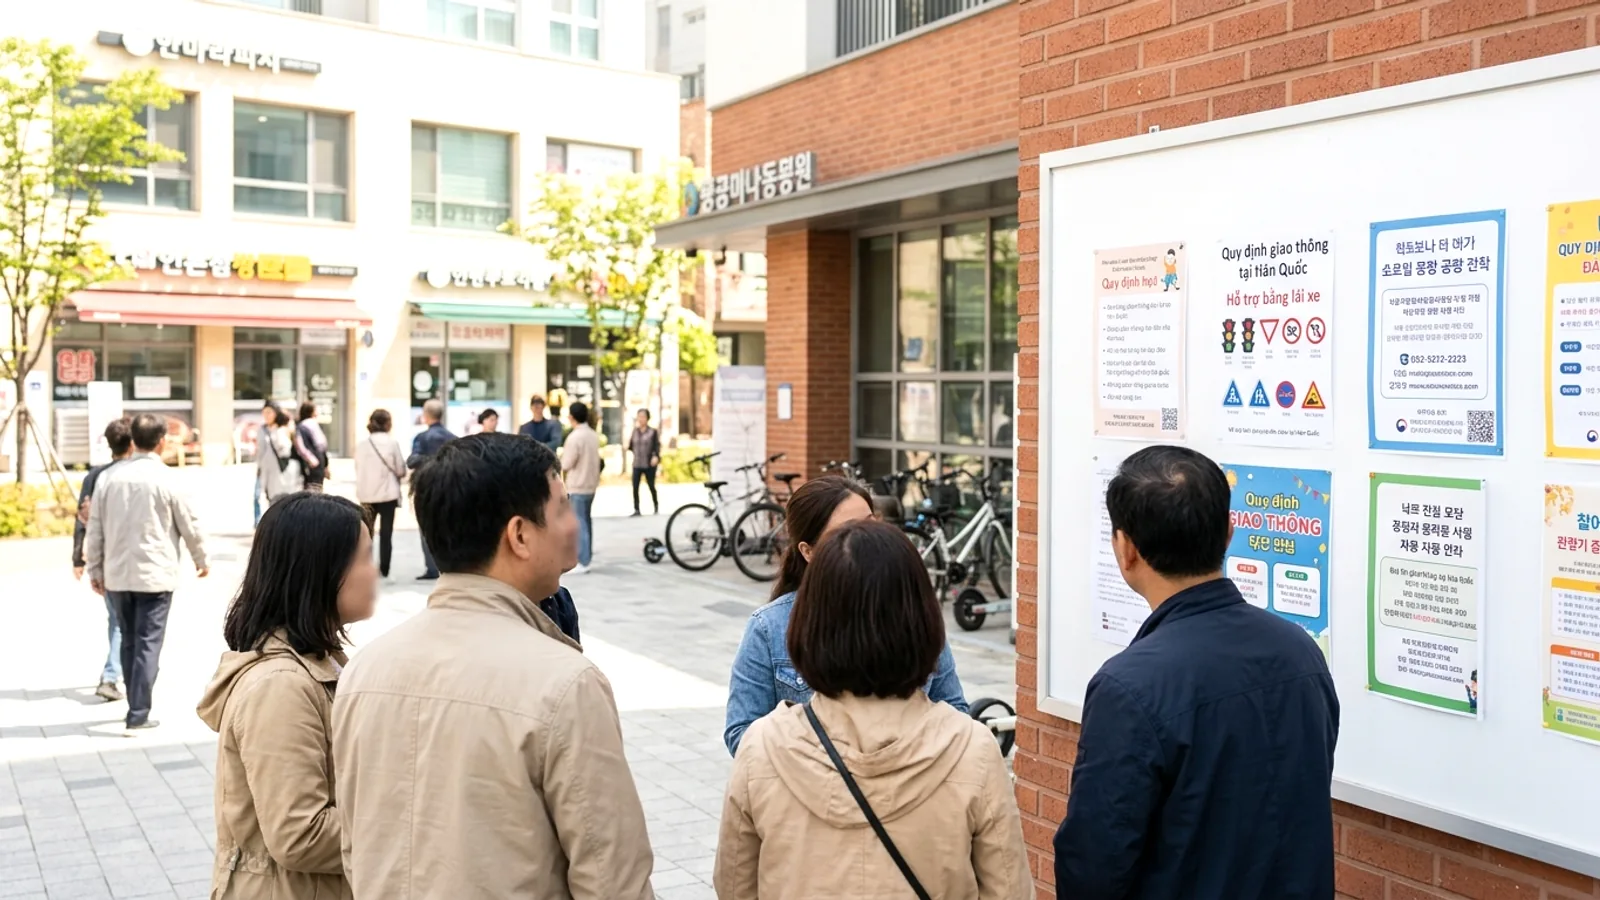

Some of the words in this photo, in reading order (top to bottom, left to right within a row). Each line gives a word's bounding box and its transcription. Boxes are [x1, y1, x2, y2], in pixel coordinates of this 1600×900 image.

[1222, 246, 1242, 261] Quy
[1270, 241, 1293, 260] giao
[1295, 238, 1329, 255] thông
[1558, 242, 1582, 257] QUY
[1239, 263, 1252, 281] tại
[1279, 258, 1308, 278] Quốc
[1243, 293, 1260, 308] trợ
[1292, 288, 1305, 303] lái
[1307, 291, 1321, 302] xe
[1229, 511, 1262, 529] GIAO
[1265, 511, 1322, 536] THÔNG
